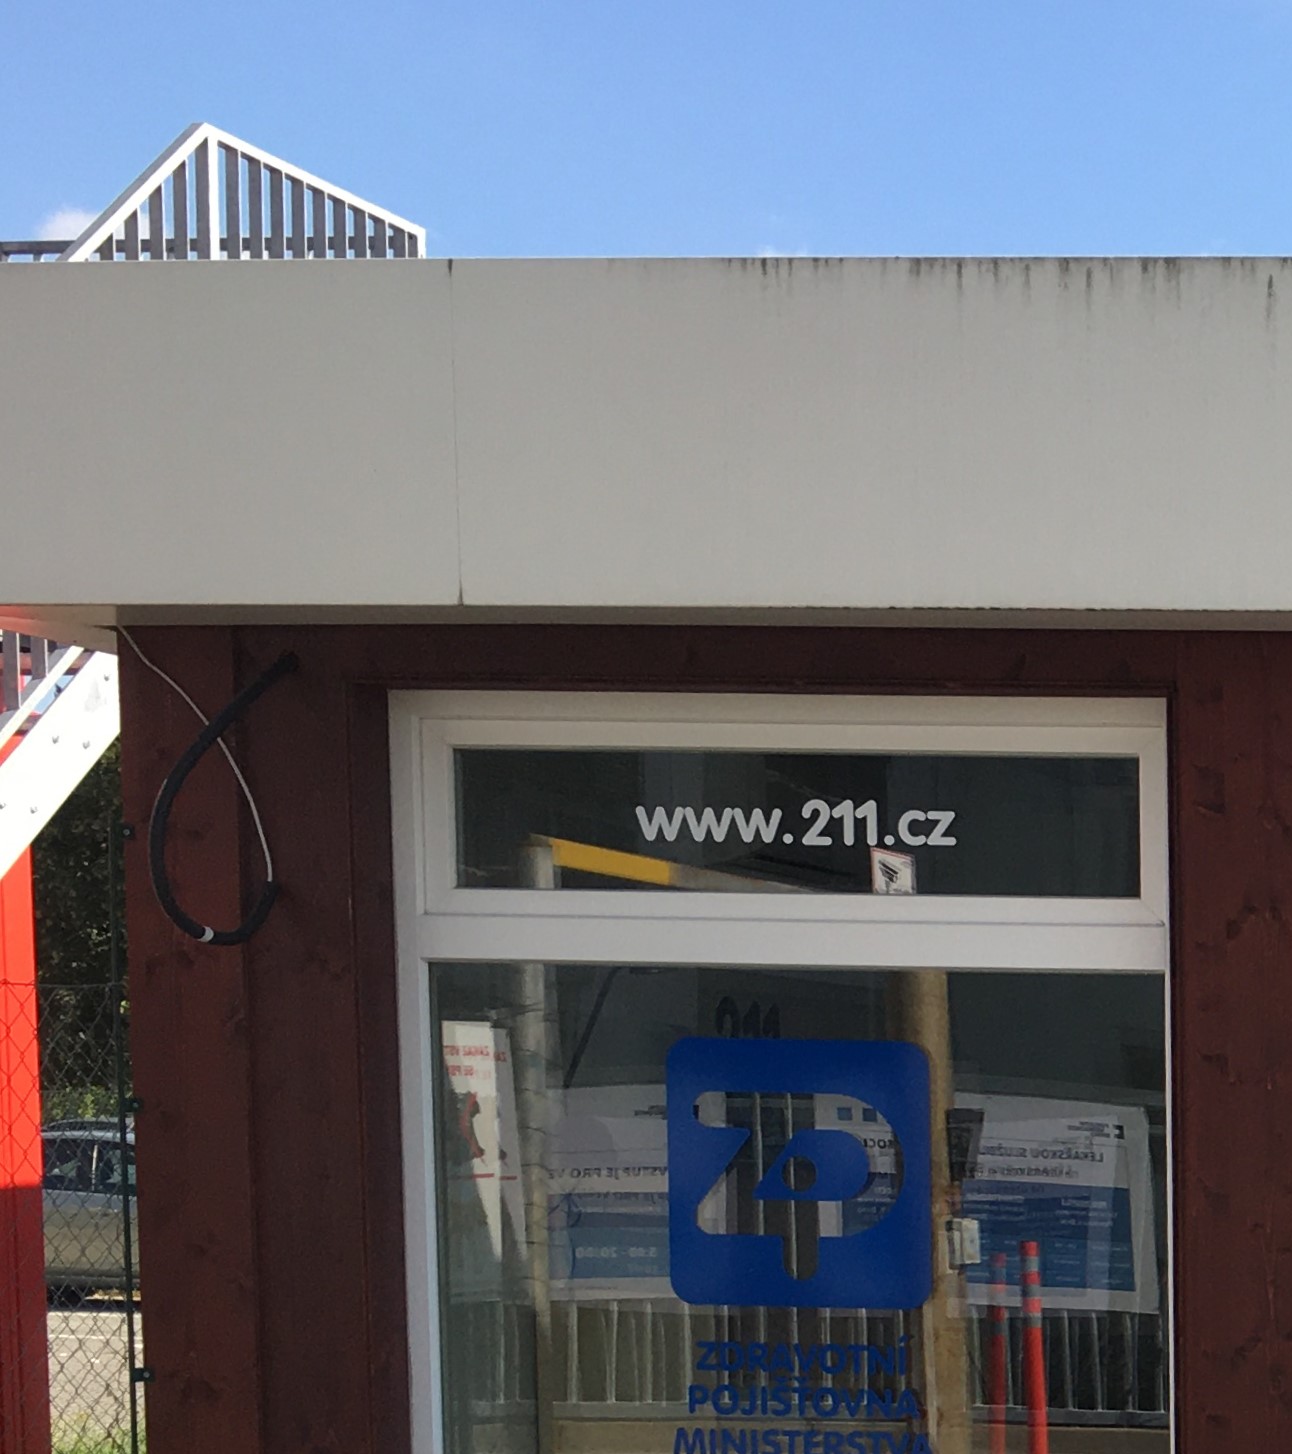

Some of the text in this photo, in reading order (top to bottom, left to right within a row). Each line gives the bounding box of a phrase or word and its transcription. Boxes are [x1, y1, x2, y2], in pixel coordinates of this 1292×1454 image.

[634, 798, 957, 848] www.211.cz
[695, 1335, 909, 1377] ZDRAVOTNÍ
[688, 1376, 921, 1421] POJIŠŤOVNA
